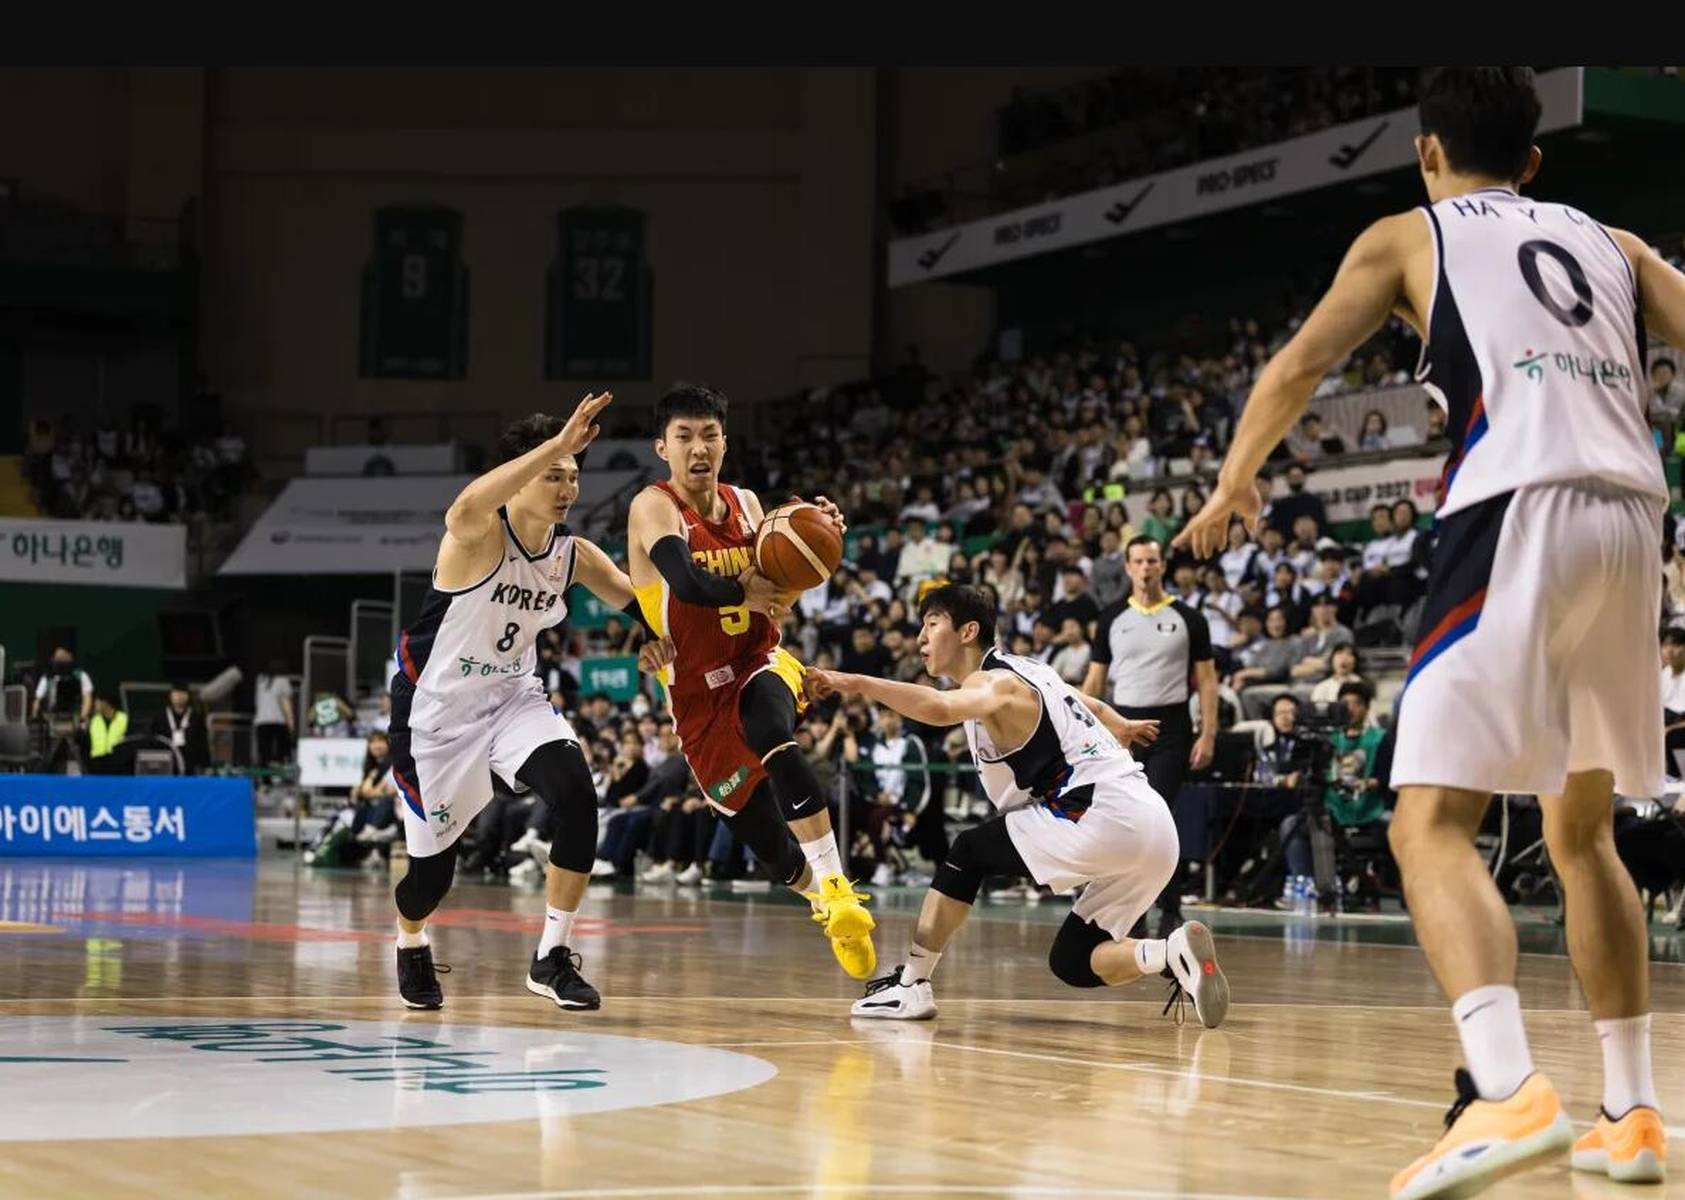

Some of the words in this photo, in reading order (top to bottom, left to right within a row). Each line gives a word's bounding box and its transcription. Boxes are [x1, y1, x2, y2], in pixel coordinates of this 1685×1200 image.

[1452, 199, 1502, 217] HA
[573, 255, 625, 301] 32
[1517, 239, 1593, 328] 0
[13, 532, 124, 569] 하나은행
[496, 622, 520, 652] 8
